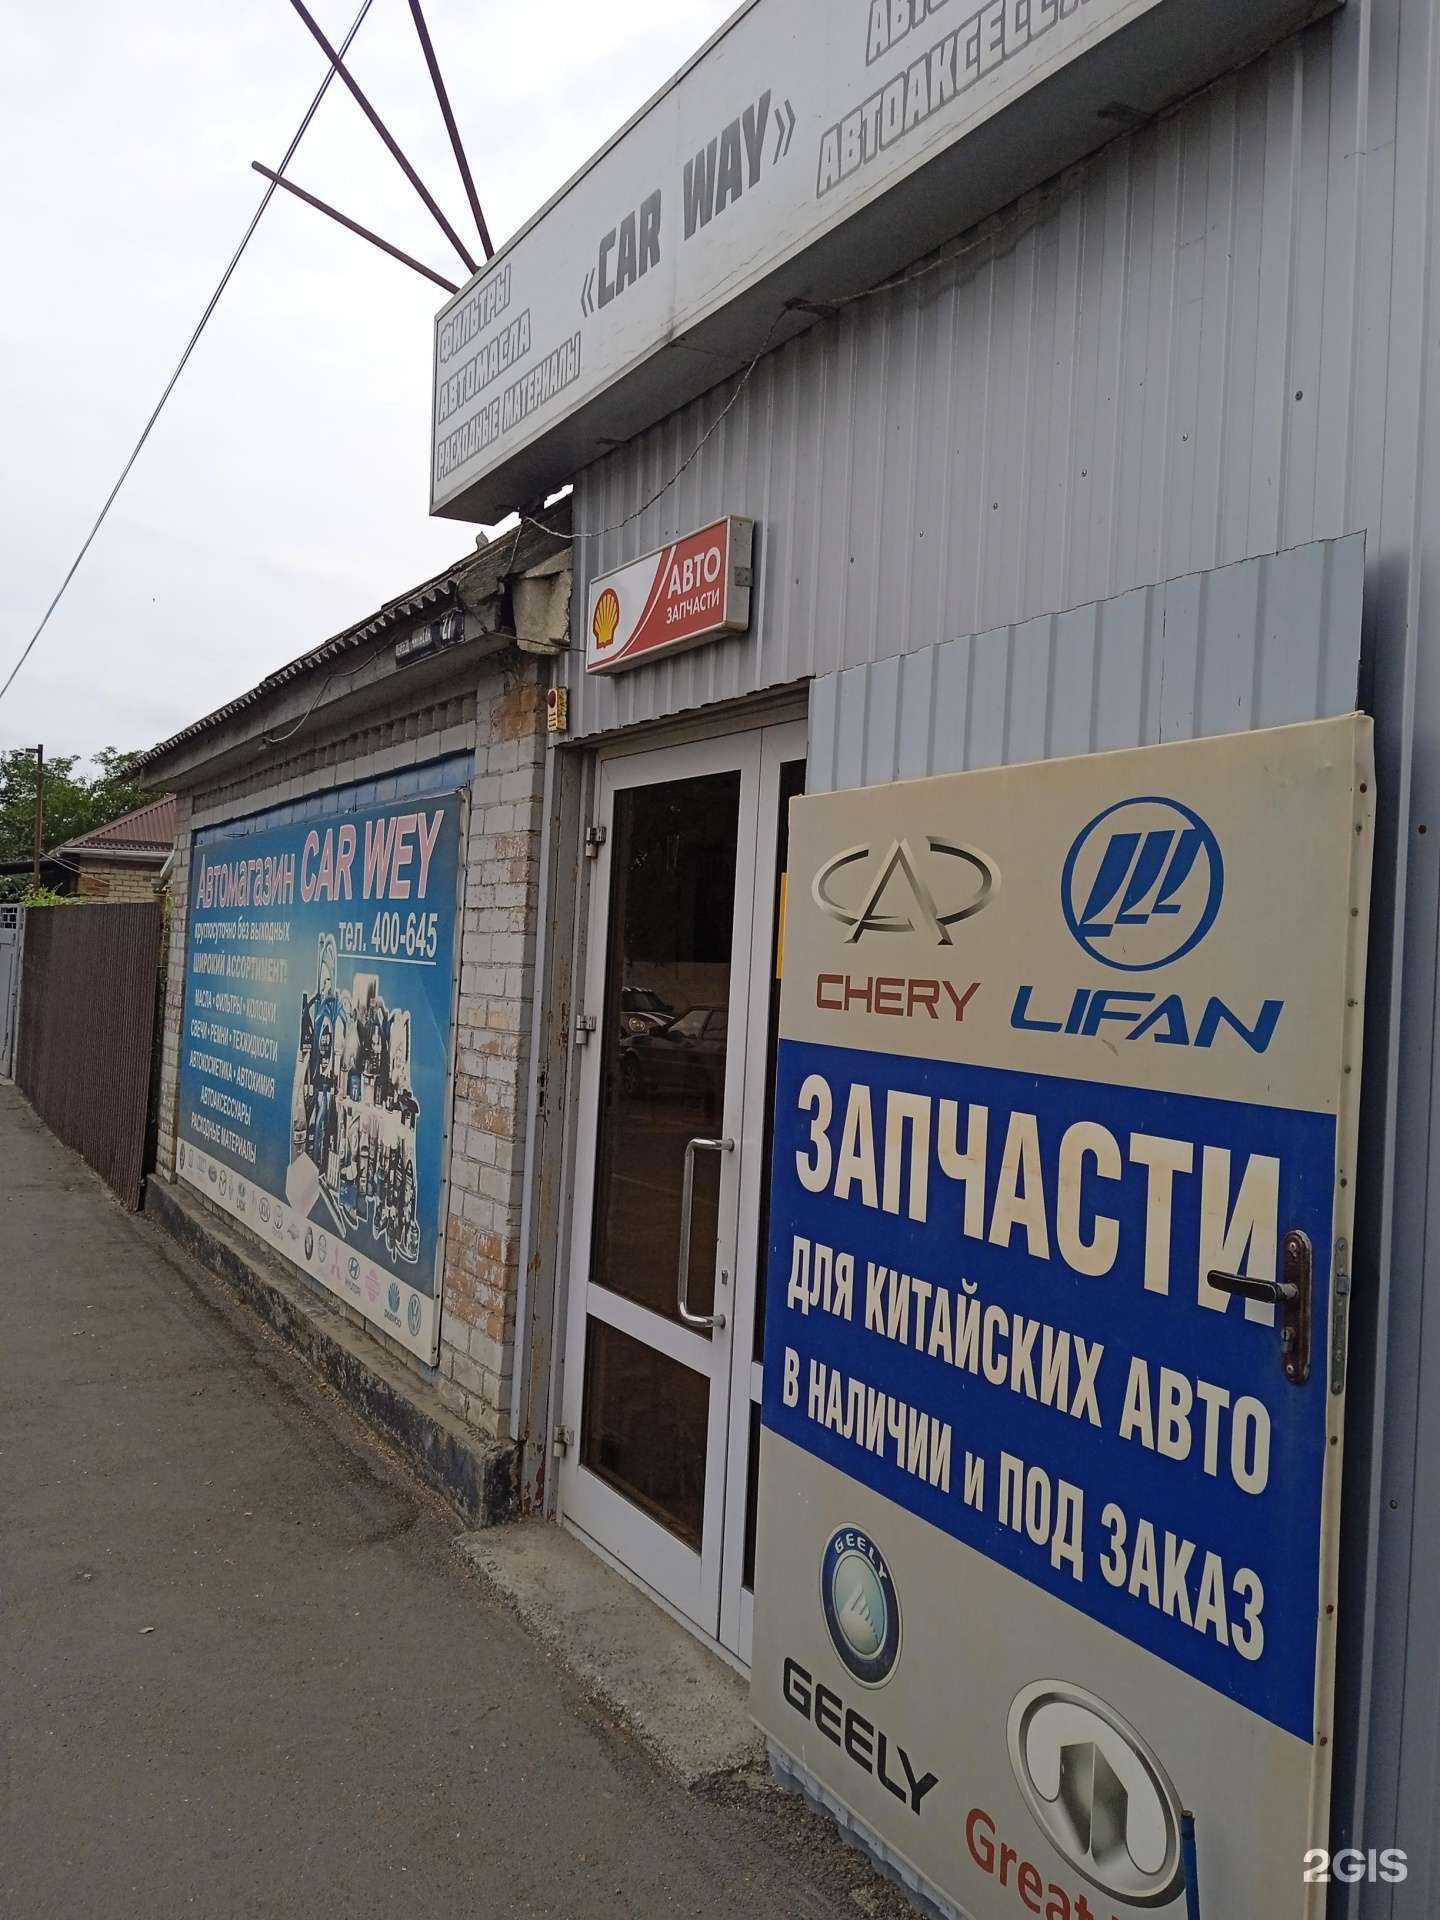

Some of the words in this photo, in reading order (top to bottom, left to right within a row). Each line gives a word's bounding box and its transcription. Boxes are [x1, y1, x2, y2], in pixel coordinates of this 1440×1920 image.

[440, 263, 511, 364] ФИЛЬТРЫ
[438, 307, 531, 425] АВТОМАСЛА
[437, 396, 500, 482] РАСХОДНЫЕ
[502, 330, 581, 434] МАТЕРИАЛЫ
[667, 546, 721, 599] АВТО
[666, 588, 720, 625] ЗАПЧАСТИ
[301, 824, 357, 903] CAR
[363, 810, 445, 900] WEY
[194, 921, 237, 945] круглосуточно
[237, 915, 249, 940] без
[250, 921, 290, 945] выходных
[338, 921, 367, 952] тел.
[371, 912, 438, 959] 400-645
[193, 950, 226, 976] ШИРОКИЙ
[195, 988, 212, 1009] МАСЛА
[215, 992, 241, 1015] ФИЛЬТРЫ
[246, 998, 278, 1025] КОЛОДКИ
[815, 973, 981, 1022] CHERY
[1010, 985, 1285, 1055] LIFAN
[190, 1019, 208, 1040] СВЕЧИ
[210, 1023, 229, 1046] РЕМНИ
[189, 1050, 233, 1082] АВТОКОСМЕТИКА
[237, 1066, 275, 1099] АВТОХИМИЯ
[200, 1085, 252, 1126] АВТОАКСЕССУАРЫ
[191, 1111, 221, 1145] РАСХОДНЫЕ
[222, 1127, 257, 1165] МАТЕРИАЛЫ
[795, 1072, 1281, 1328] ЗАПЧАСТИ
[787, 1235, 855, 1322] ДЛЯ
[865, 1278, 1105, 1429] КИТАЙСКИХ
[1119, 1355, 1272, 1496] АВТО
[783, 1347, 799, 1408] В
[808, 1358, 952, 1495] НАЛИЧИИ
[965, 1449, 985, 1512] и
[998, 1451, 1085, 1583] ПОД
[1100, 1502, 1265, 1661] ЗАКАЗ
[835, 1533, 887, 1579] GEELY
[782, 1656, 939, 1816] GEELY
